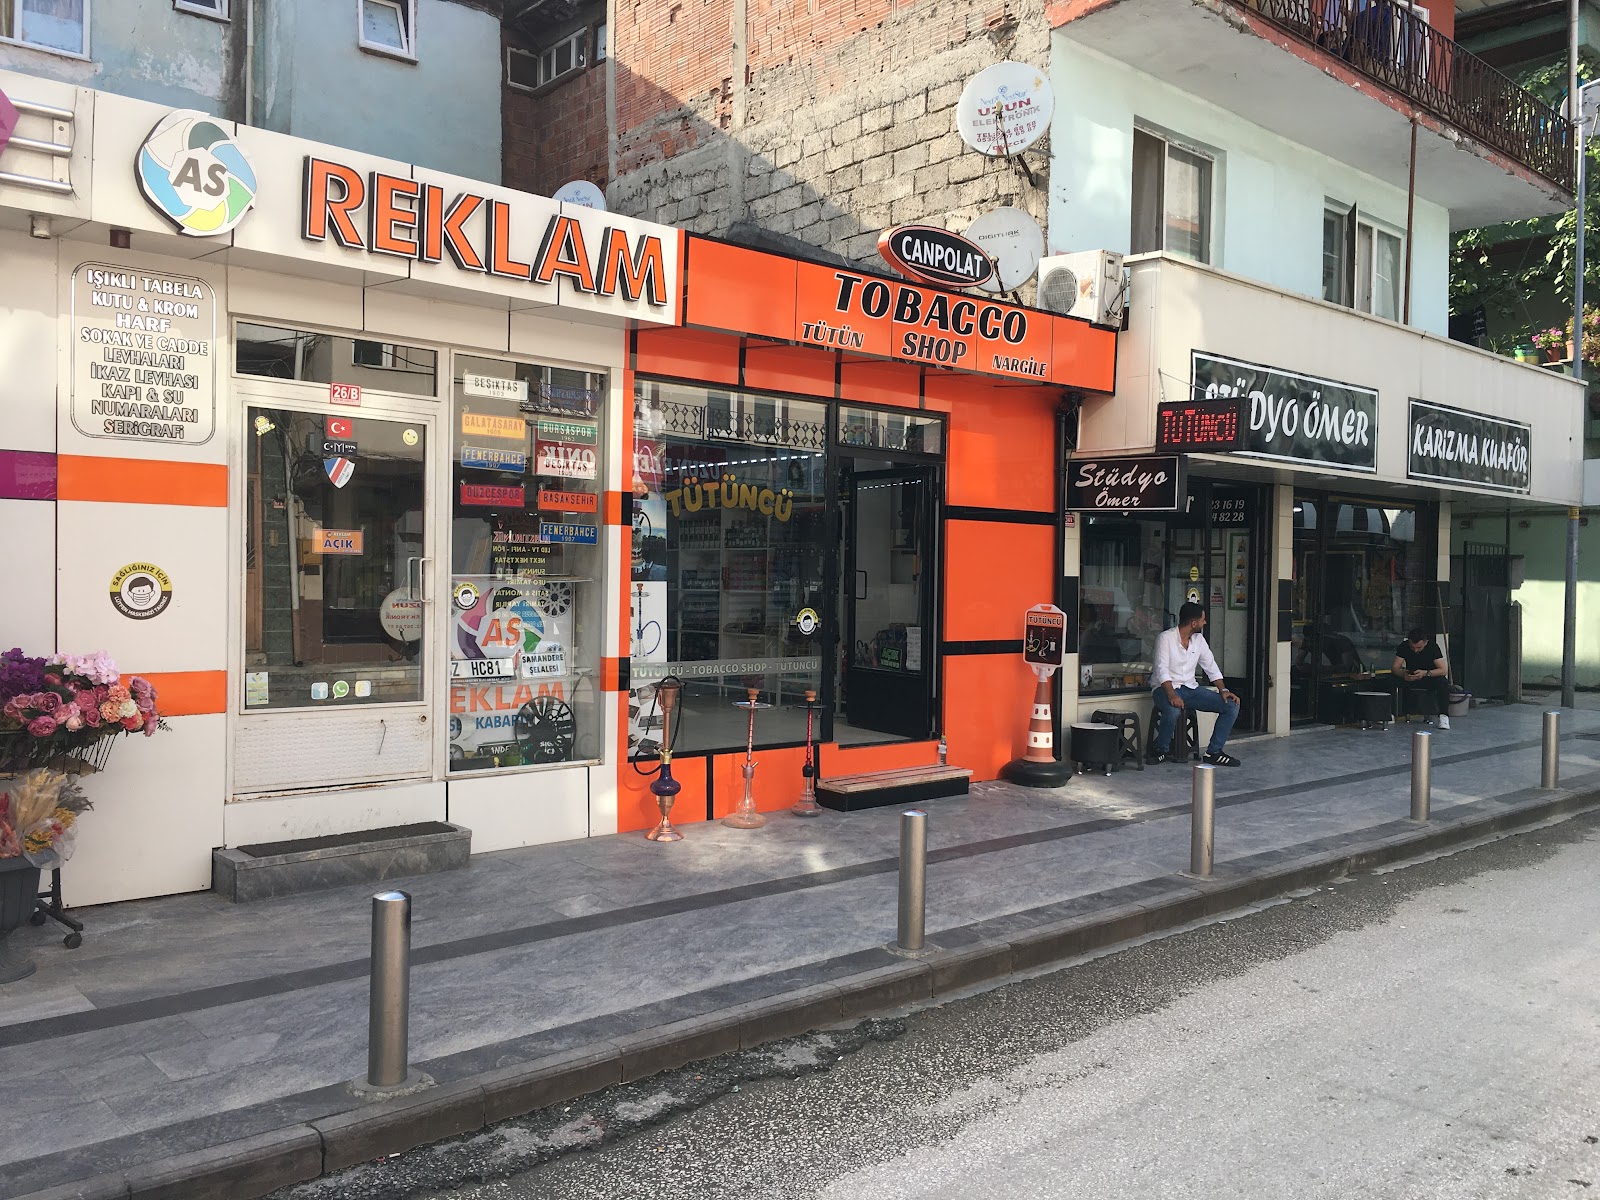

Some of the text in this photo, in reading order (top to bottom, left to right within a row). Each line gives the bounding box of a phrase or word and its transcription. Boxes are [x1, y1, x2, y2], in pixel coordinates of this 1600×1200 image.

[172, 158, 227, 198] AS
[302, 155, 667, 307] REKLAM
[901, 235, 984, 278] CANPOLAT
[87, 268, 203, 300] IŞIKLI TABELA
[91, 290, 199, 319] KUTU & KROM
[834, 272, 1028, 345] TOBACCO
[115, 312, 172, 333] HARF
[801, 320, 864, 349] TÜTÜN
[80, 326, 208, 356] SOKAK VE CADDE
[901, 332, 968, 364] SHOP
[103, 347, 185, 371] LEVHALARI
[992, 354, 1047, 377] NARGİLE
[90, 361, 199, 389] İKAZ LEVHASI
[101, 383, 184, 404] KAPI & SU
[333, 385, 358, 400] 26/B
[91, 399, 199, 423] NUMARALARI
[464, 415, 523, 431] GALATASARAY
[1303, 390, 1369, 446] ÖMER
[543, 422, 592, 438] BURSASPOR
[1074, 463, 1168, 494] Stüdyo
[664, 473, 794, 523] TÜTÜNCÜ
[1095, 487, 1140, 507] Ömer
[1222, 499, 1233, 510] 16
[1234, 499, 1245, 509] 19
[1218, 512, 1231, 522] 82
[1232, 511, 1245, 522] 28
[542, 524, 595, 538] FENERBAHCE
[323, 539, 354, 550] AÇIK
[481, 617, 522, 648] AS
[471, 660, 501, 676] HC81
[522, 653, 564, 664] SAMANDERE
[632, 664, 683, 678] TÜTÜNCÜ
[691, 663, 739, 675] TOBACCO
[741, 662, 767, 673] SHOP
[774, 658, 818, 671] TÜTÜNCÜ
